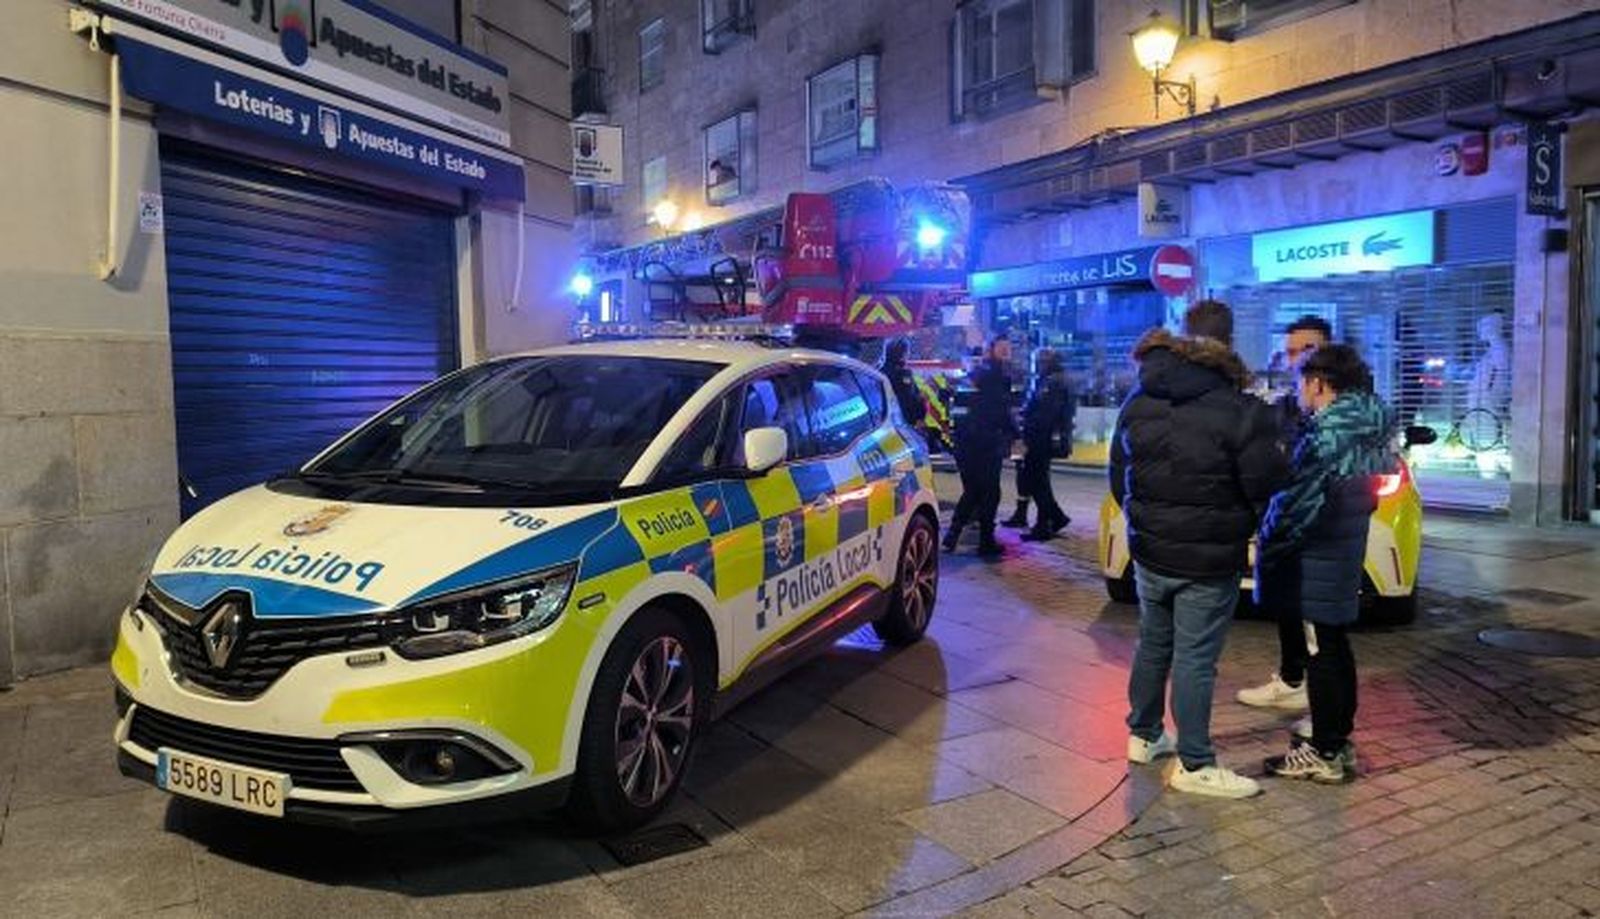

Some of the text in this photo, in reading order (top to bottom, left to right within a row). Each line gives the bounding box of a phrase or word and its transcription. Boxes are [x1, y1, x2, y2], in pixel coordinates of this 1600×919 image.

[320, 17, 415, 77] Apuestas
[418, 58, 445, 91] del
[449, 72, 501, 113] Estado
[301, 113, 311, 135] y
[349, 123, 415, 159] Apuestas
[419, 144, 439, 167] del
[445, 153, 486, 179] Estado
[1276, 241, 1350, 263] LACOSTE
[499, 510, 548, 531] 708
[836, 534, 871, 581] Local
[170, 758, 276, 808] 5589 LRC
